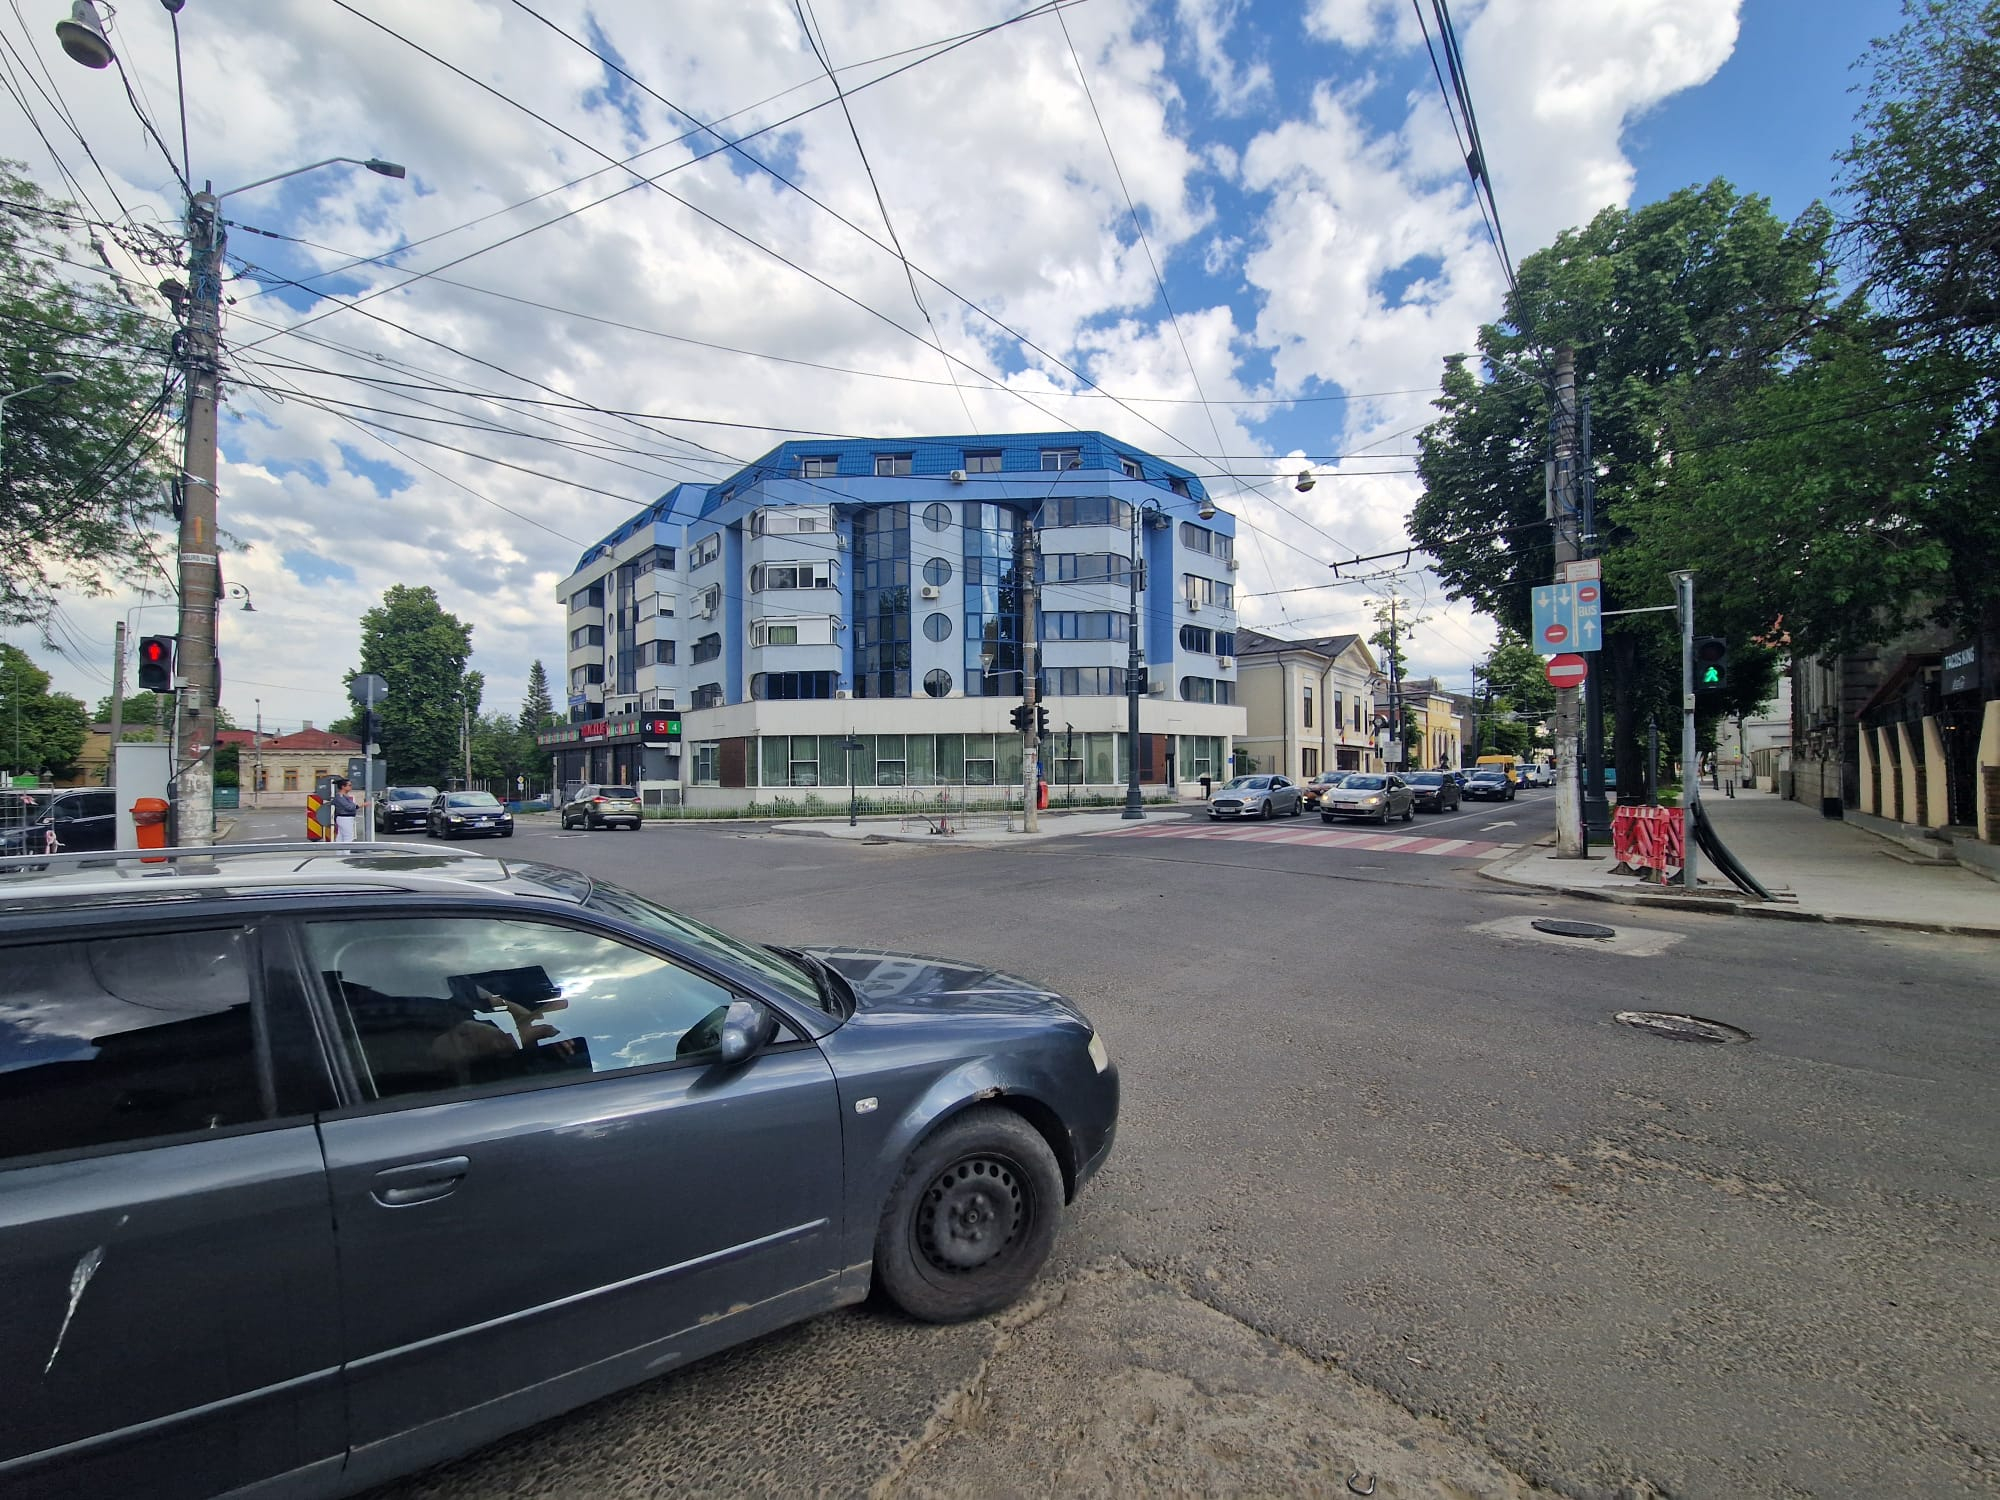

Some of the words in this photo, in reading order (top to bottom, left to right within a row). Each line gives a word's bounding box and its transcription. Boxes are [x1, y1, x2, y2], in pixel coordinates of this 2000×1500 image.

[1579, 605, 1597, 617] BUS
[645, 722, 652, 731] 6
[658, 722, 665, 732] 5
[671, 723, 678, 732] 4
